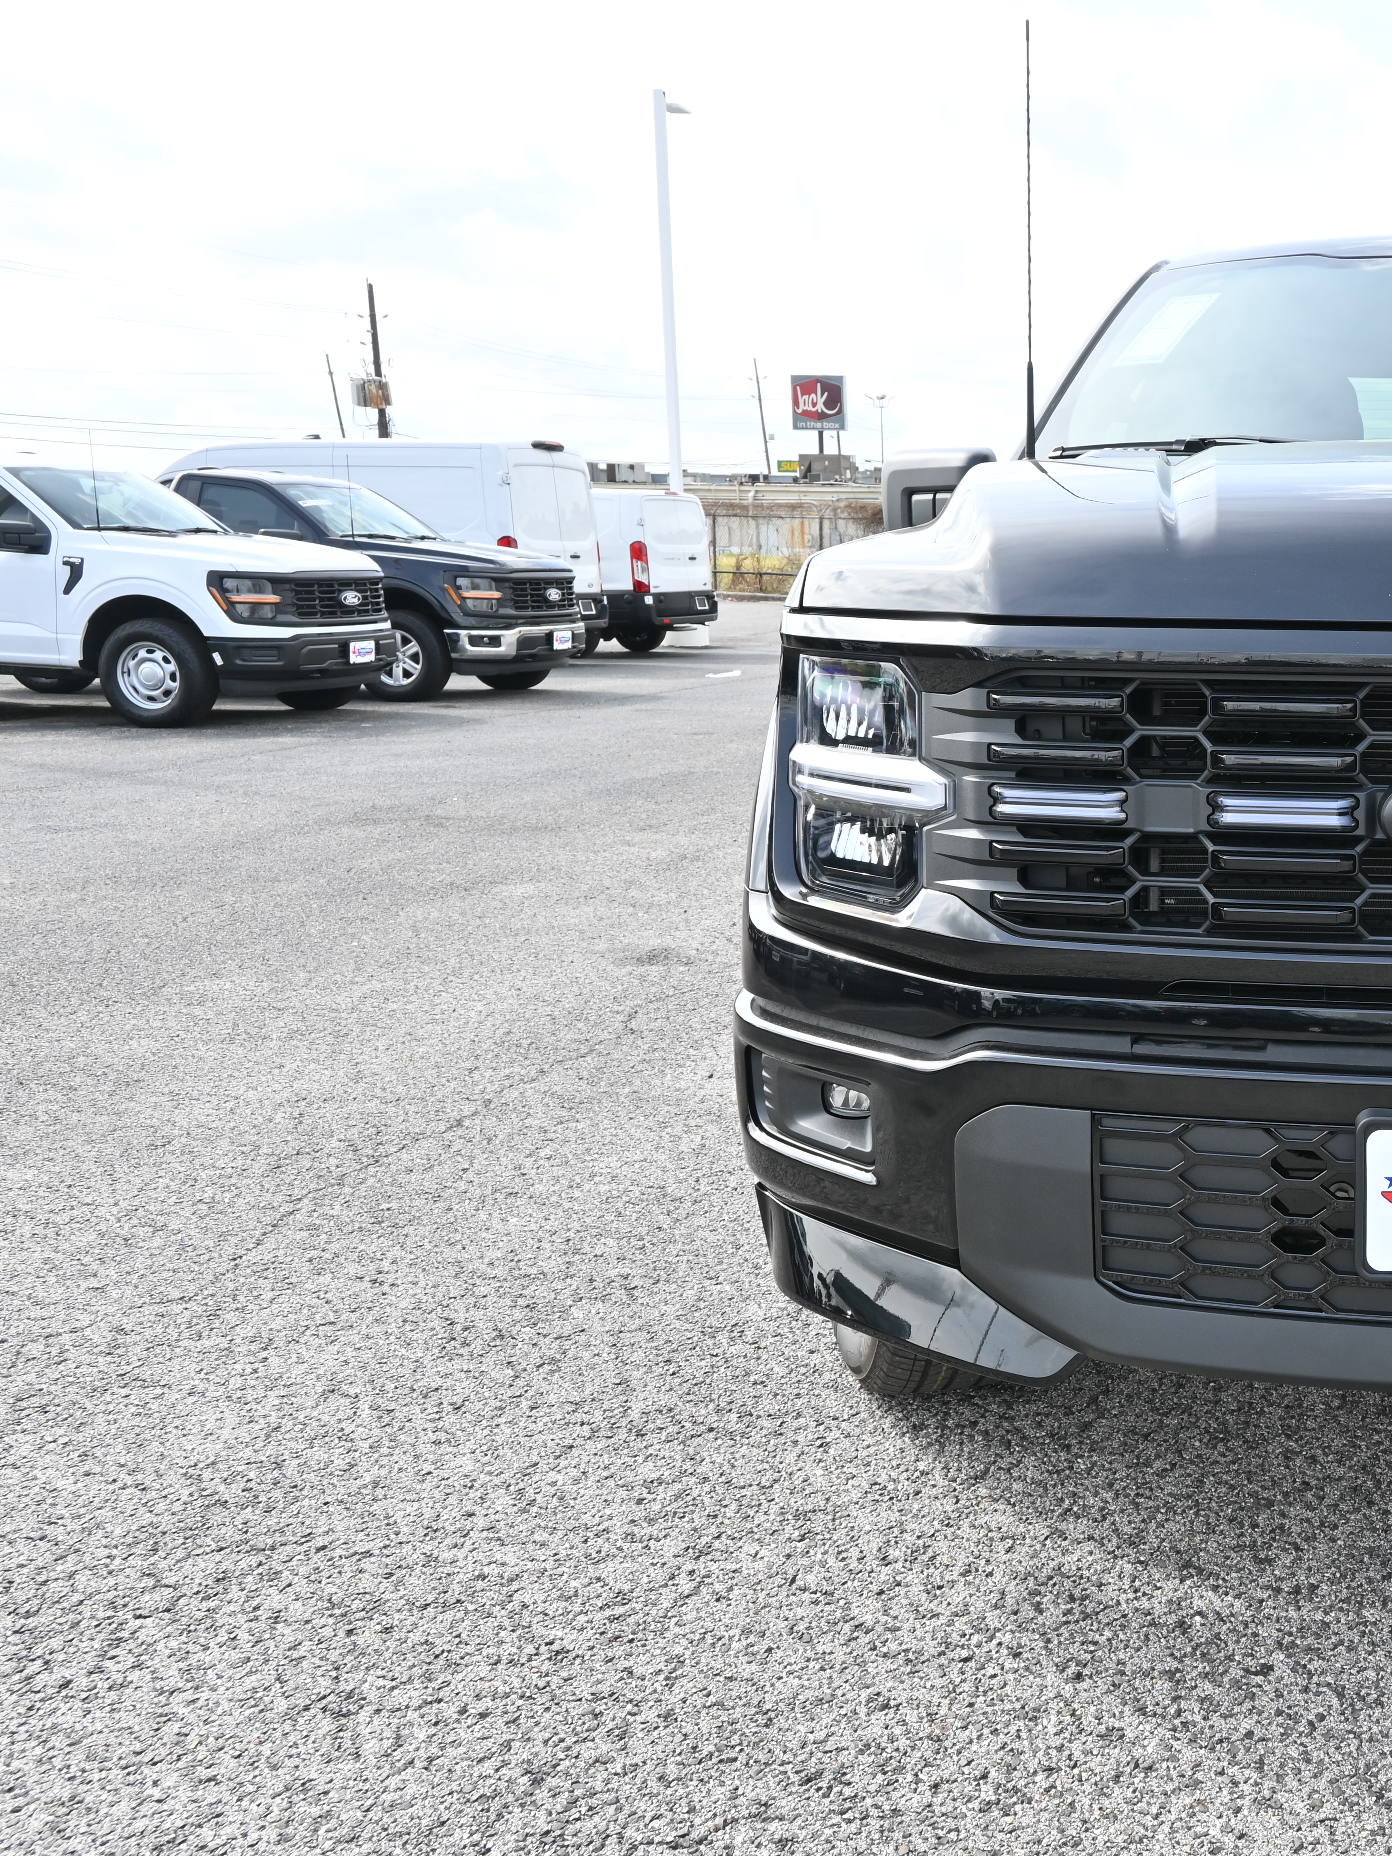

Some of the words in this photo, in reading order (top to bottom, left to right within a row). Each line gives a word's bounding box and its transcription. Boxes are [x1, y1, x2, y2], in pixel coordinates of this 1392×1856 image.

[794, 382, 841, 414] Jack
[797, 421, 806, 429] in
[807, 421, 821, 429] the
[823, 421, 840, 429] box
